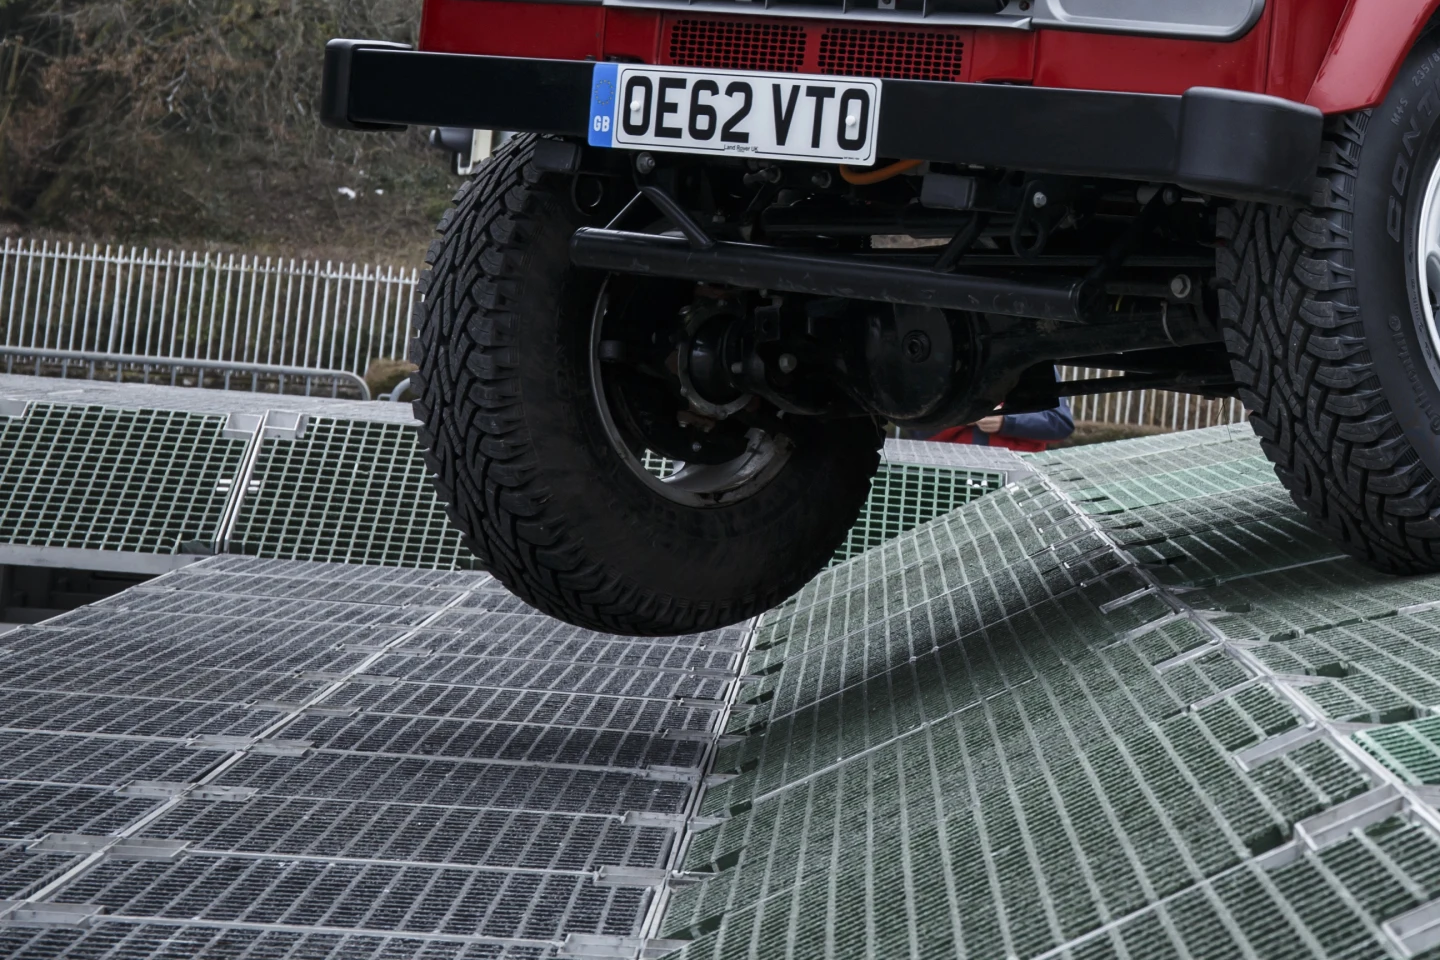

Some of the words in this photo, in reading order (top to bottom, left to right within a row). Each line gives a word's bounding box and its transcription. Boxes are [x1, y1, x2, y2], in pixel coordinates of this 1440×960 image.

[593, 116, 610, 133] GB
[622, 75, 753, 144] OE62
[771, 83, 870, 151] VTO
[1390, 97, 1409, 126] M+S
